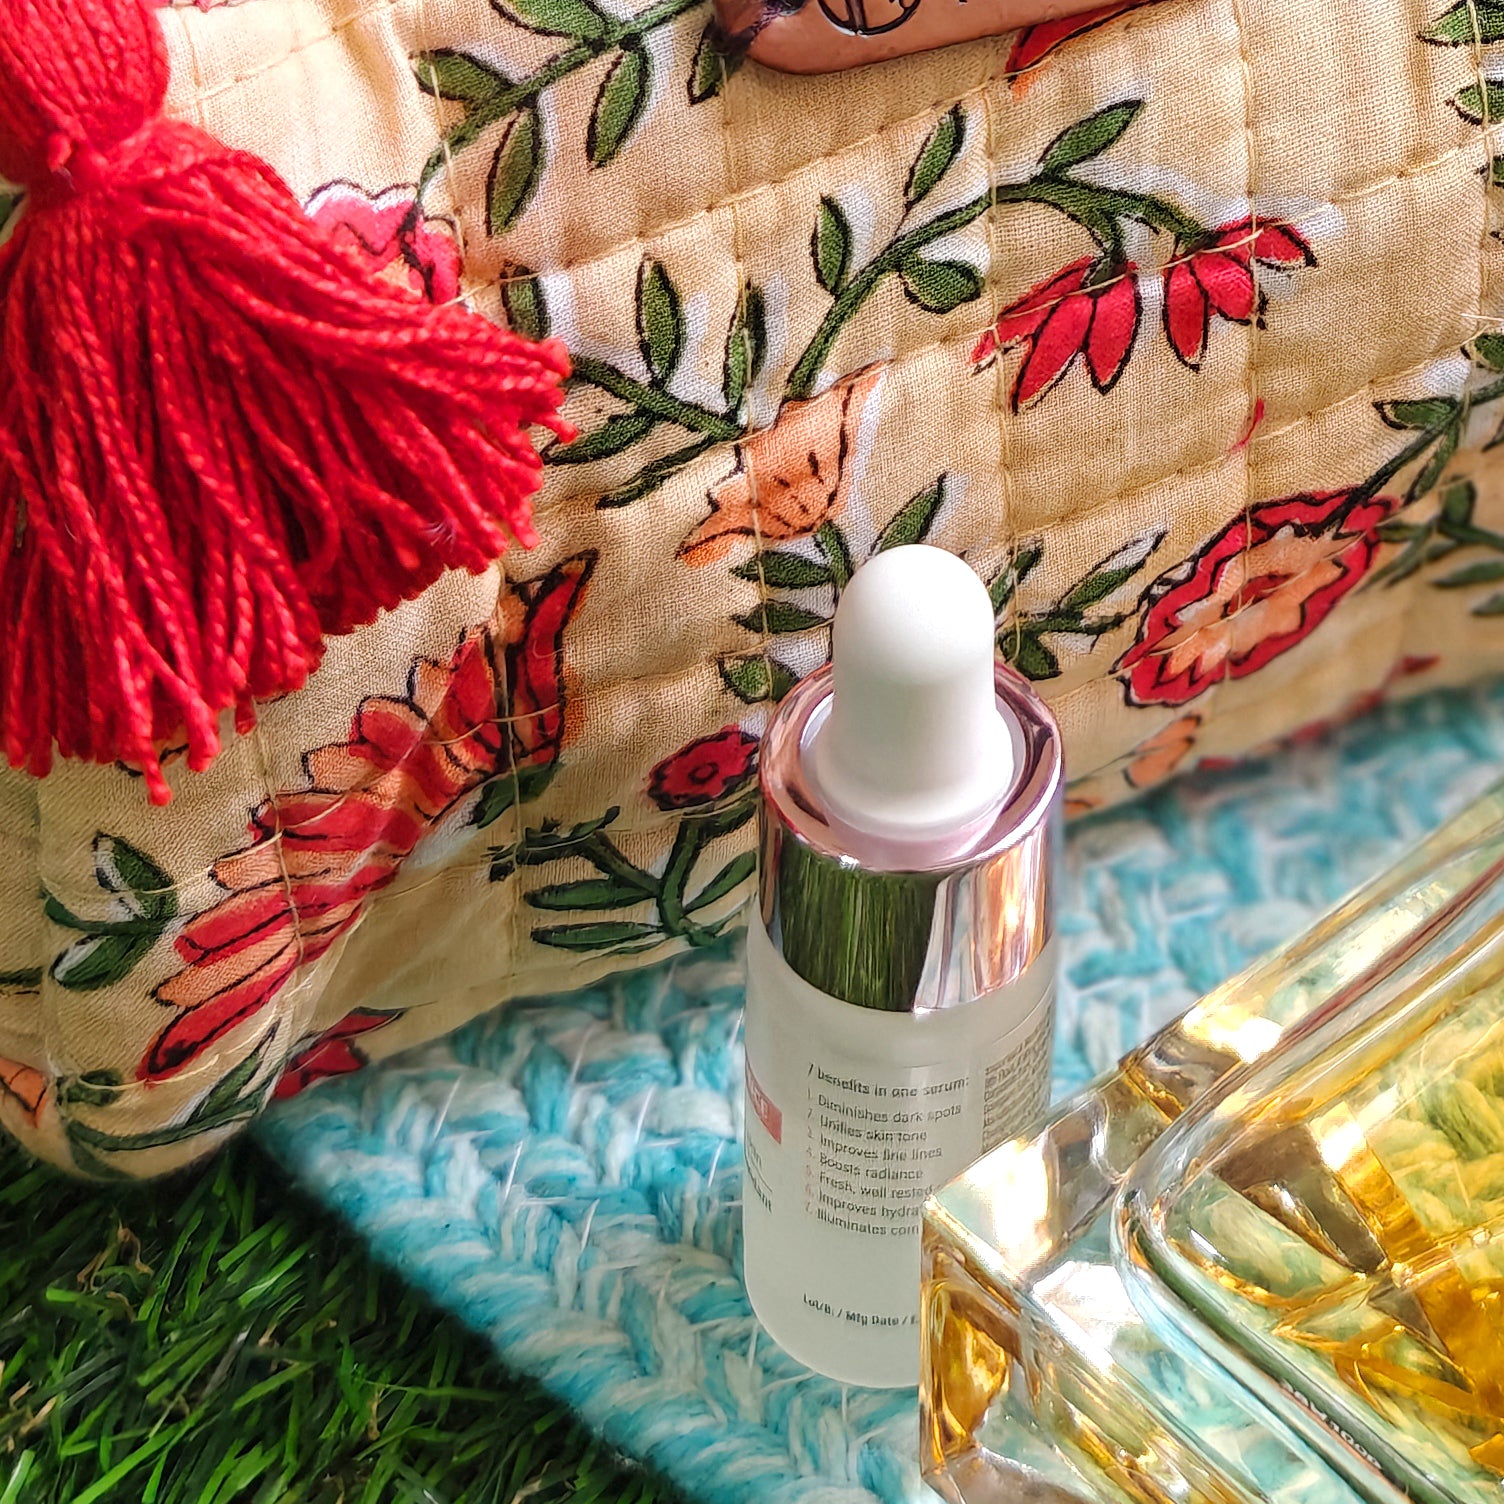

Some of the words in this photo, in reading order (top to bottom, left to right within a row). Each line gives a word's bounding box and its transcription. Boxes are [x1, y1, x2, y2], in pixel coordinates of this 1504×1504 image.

[817, 1066, 870, 1095] benefits
[818, 1093, 888, 1123] Diminishes
[892, 1110, 924, 1124] dark
[820, 1132, 879, 1160] Improves
[911, 1146, 943, 1161] lines
[866, 1128, 894, 1143] skin
[820, 1151, 862, 1176] Boosts
[865, 1167, 924, 1180] radiance
[819, 1186, 877, 1216] Improves
[860, 1184, 887, 1198] well
[817, 1207, 887, 1235] Illuminates
